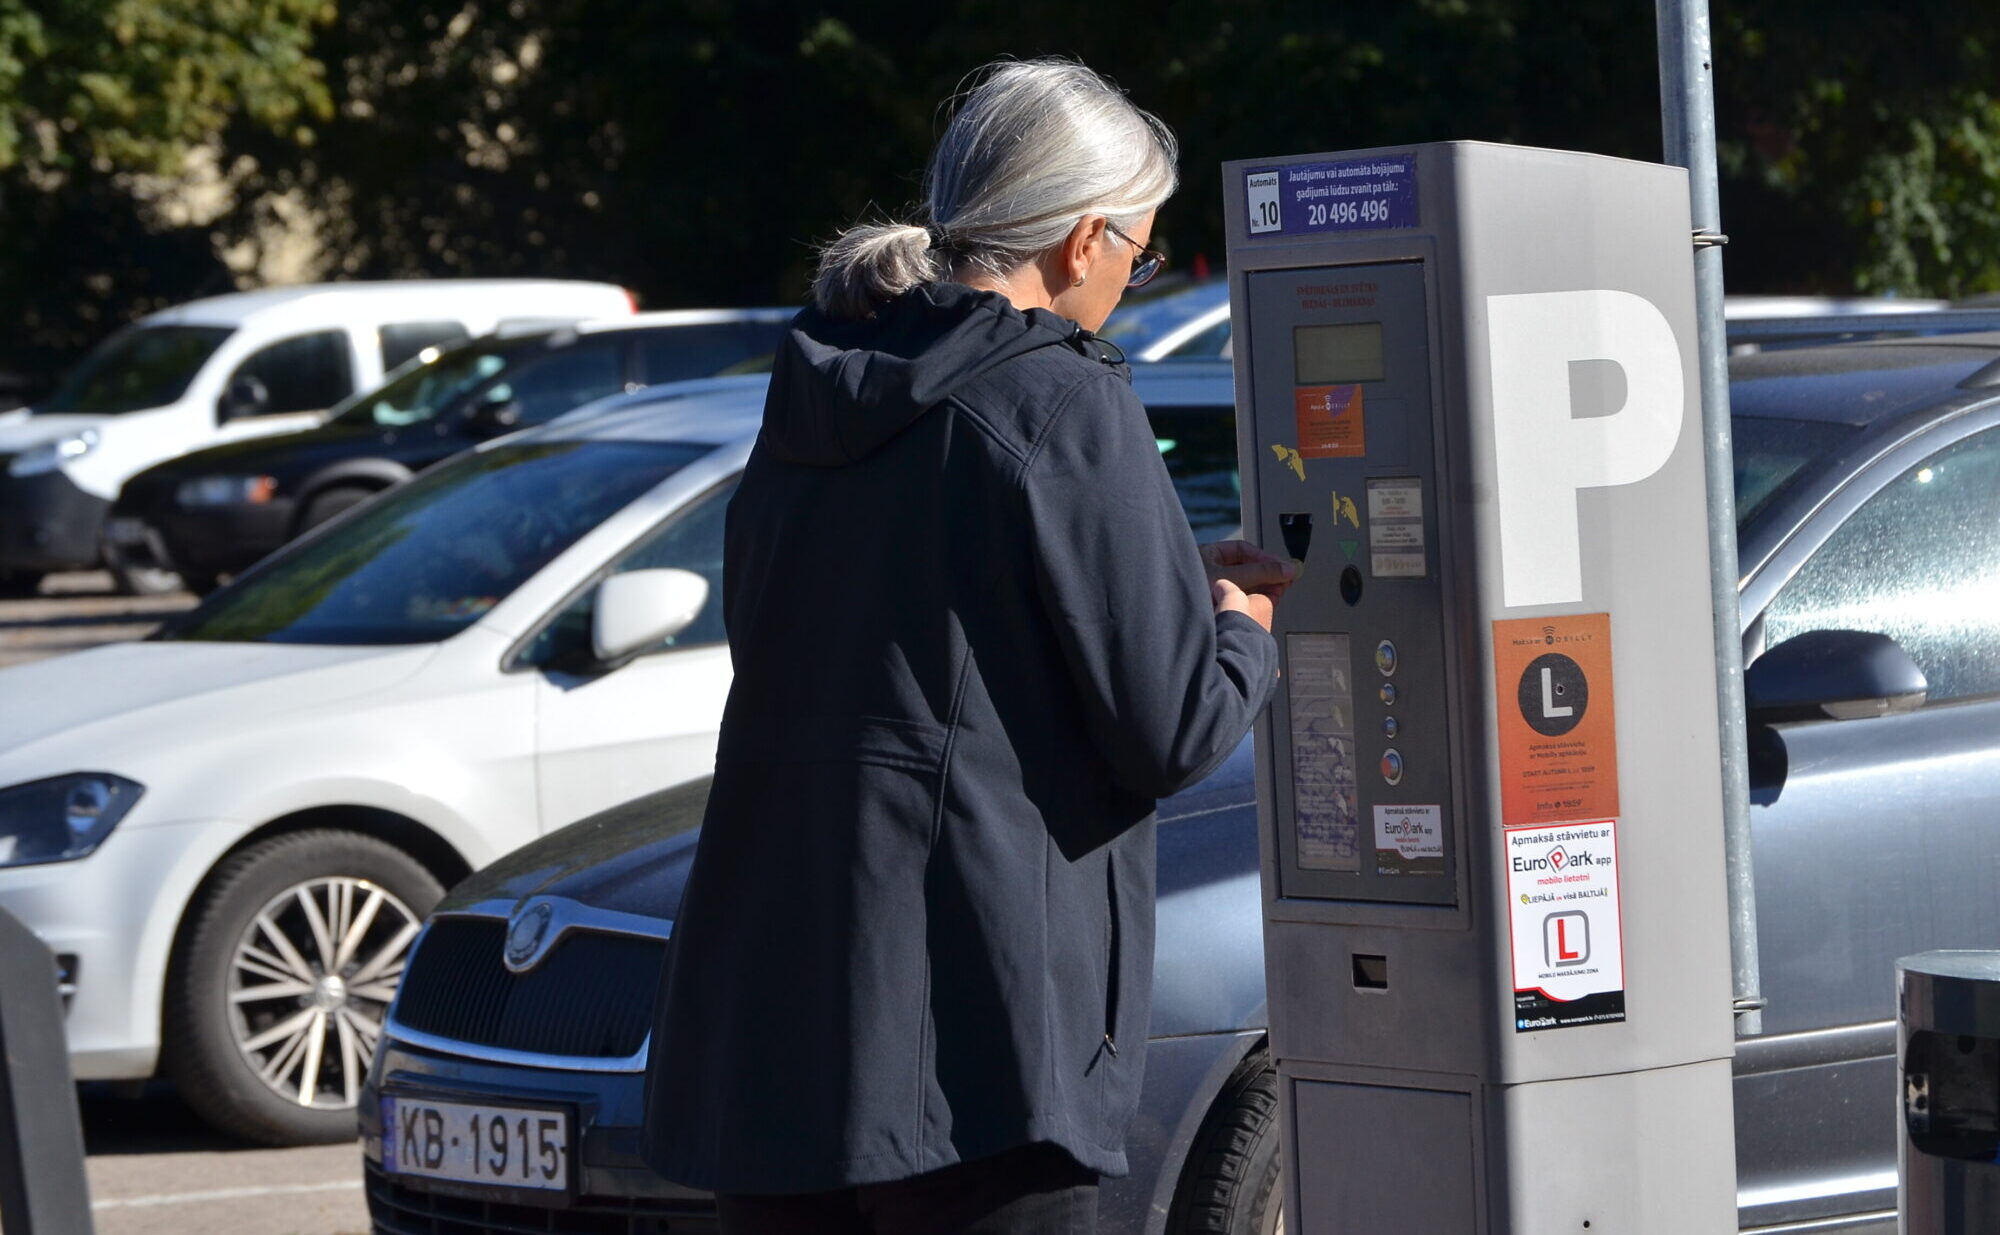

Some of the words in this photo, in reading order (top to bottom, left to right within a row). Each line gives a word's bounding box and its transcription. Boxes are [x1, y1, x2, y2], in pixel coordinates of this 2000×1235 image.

[1289, 169, 1325, 182] Jautājumu
[1326, 167, 1337, 178] vai
[1338, 164, 1371, 177] automāta
[1372, 163, 1404, 177] bojājumu
[1296, 186, 1329, 201] gadījumā
[1330, 184, 1350, 195] lūdzu
[1372, 184, 1381, 195] pa
[1260, 201, 1278, 226] 10
[1308, 204, 1326, 225] 20
[1330, 201, 1358, 223] 496
[1361, 200, 1388, 222] 496
[1486, 289, 1685, 607] P
[1541, 667, 1573, 718] L
[1385, 818, 1423, 834] EuroPark
[1512, 833, 1554, 847] Apmaksā
[1556, 829, 1598, 842] stāvvietu
[1601, 829, 1610, 837] ar
[1513, 845, 1593, 873] EuroPark
[1596, 857, 1612, 866] app
[1537, 876, 1562, 885] mobilo
[1564, 873, 1590, 883] lietotni
[1557, 919, 1579, 960] L
